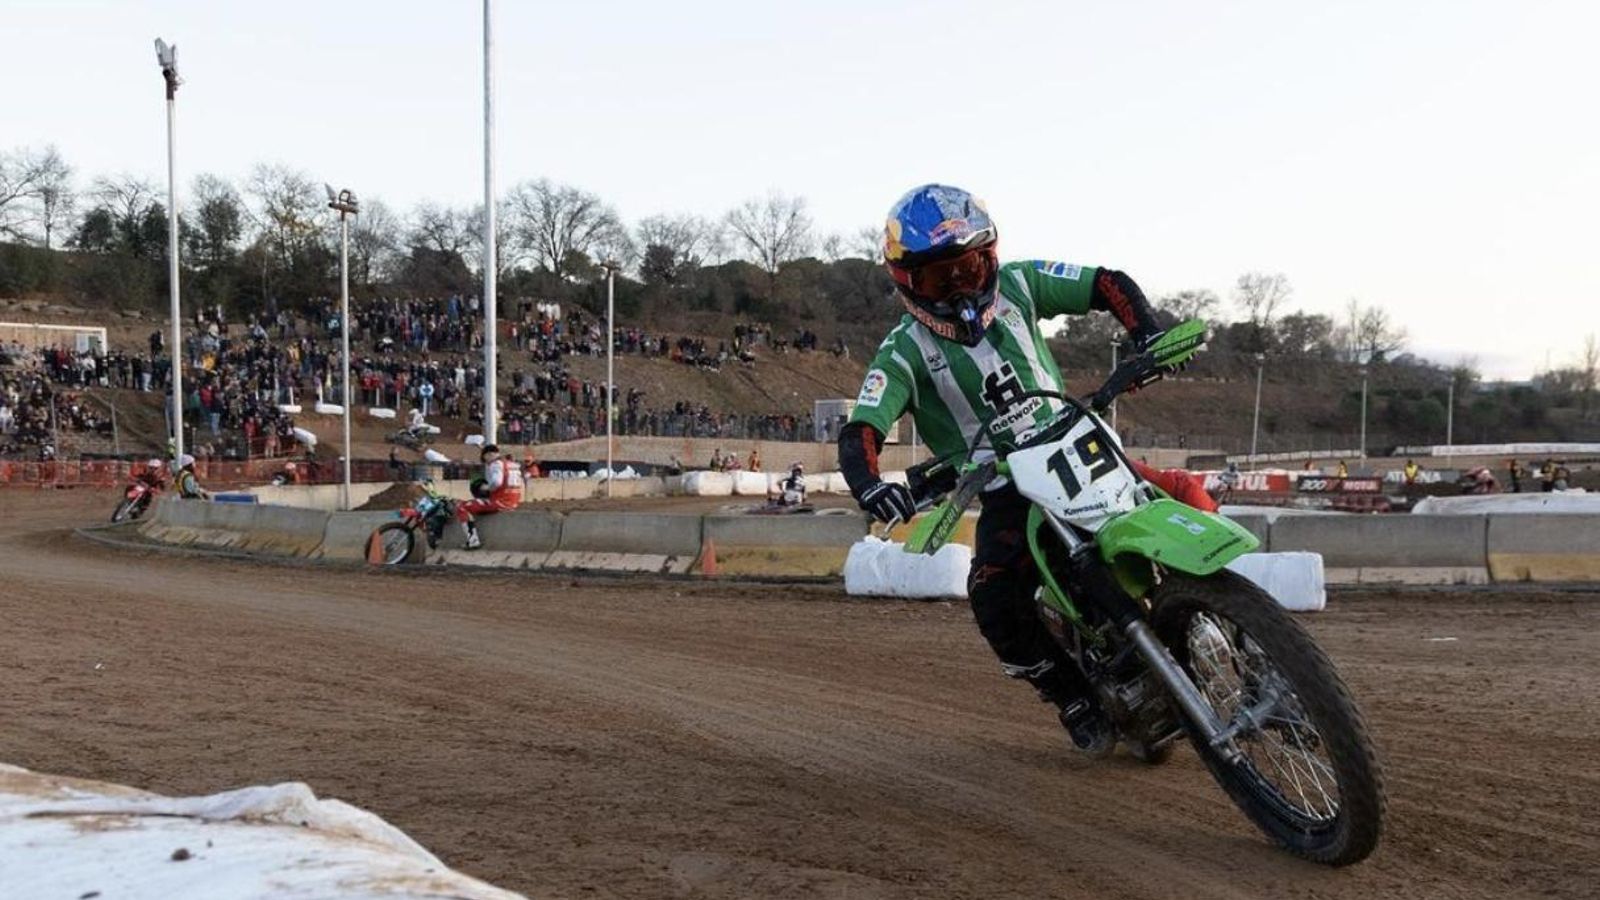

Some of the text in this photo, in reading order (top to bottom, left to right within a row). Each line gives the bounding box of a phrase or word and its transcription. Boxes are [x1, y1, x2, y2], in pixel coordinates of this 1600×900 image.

[982, 363, 1026, 416] fi
[991, 397, 1042, 432] network
[1047, 427, 1119, 501] 19
[1063, 501, 1109, 517] Kawasaki
